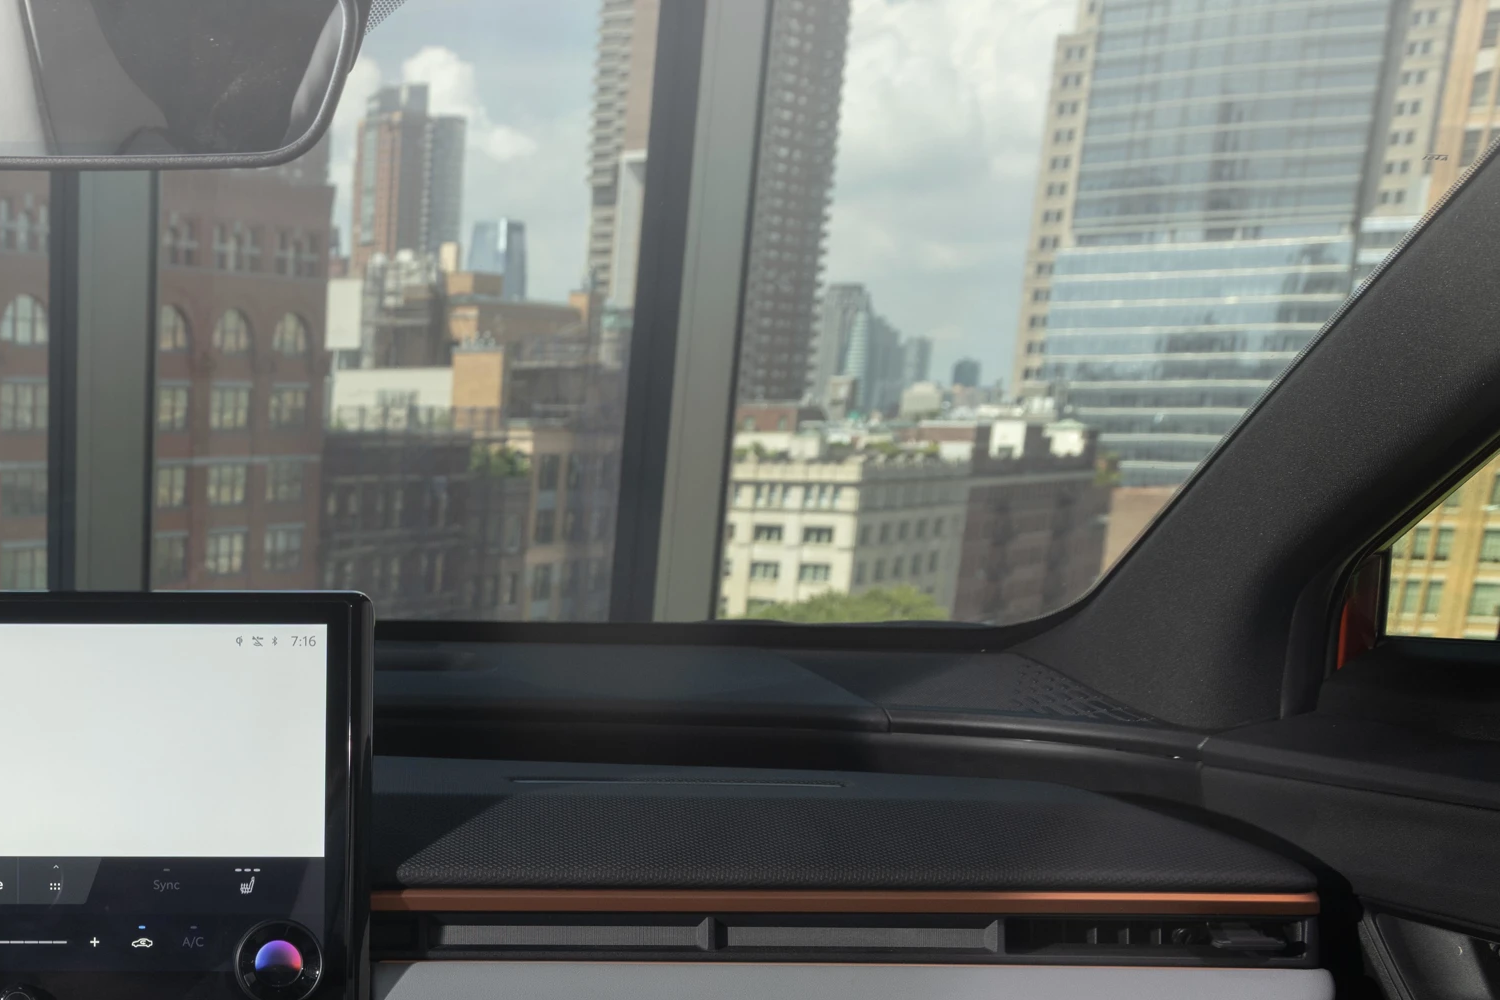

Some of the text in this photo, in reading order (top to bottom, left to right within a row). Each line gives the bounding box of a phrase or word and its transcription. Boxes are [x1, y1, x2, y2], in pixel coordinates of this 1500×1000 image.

[291, 635, 317, 647] 7:16
[153, 879, 181, 892] Sync
[182, 936, 205, 949] A/C
